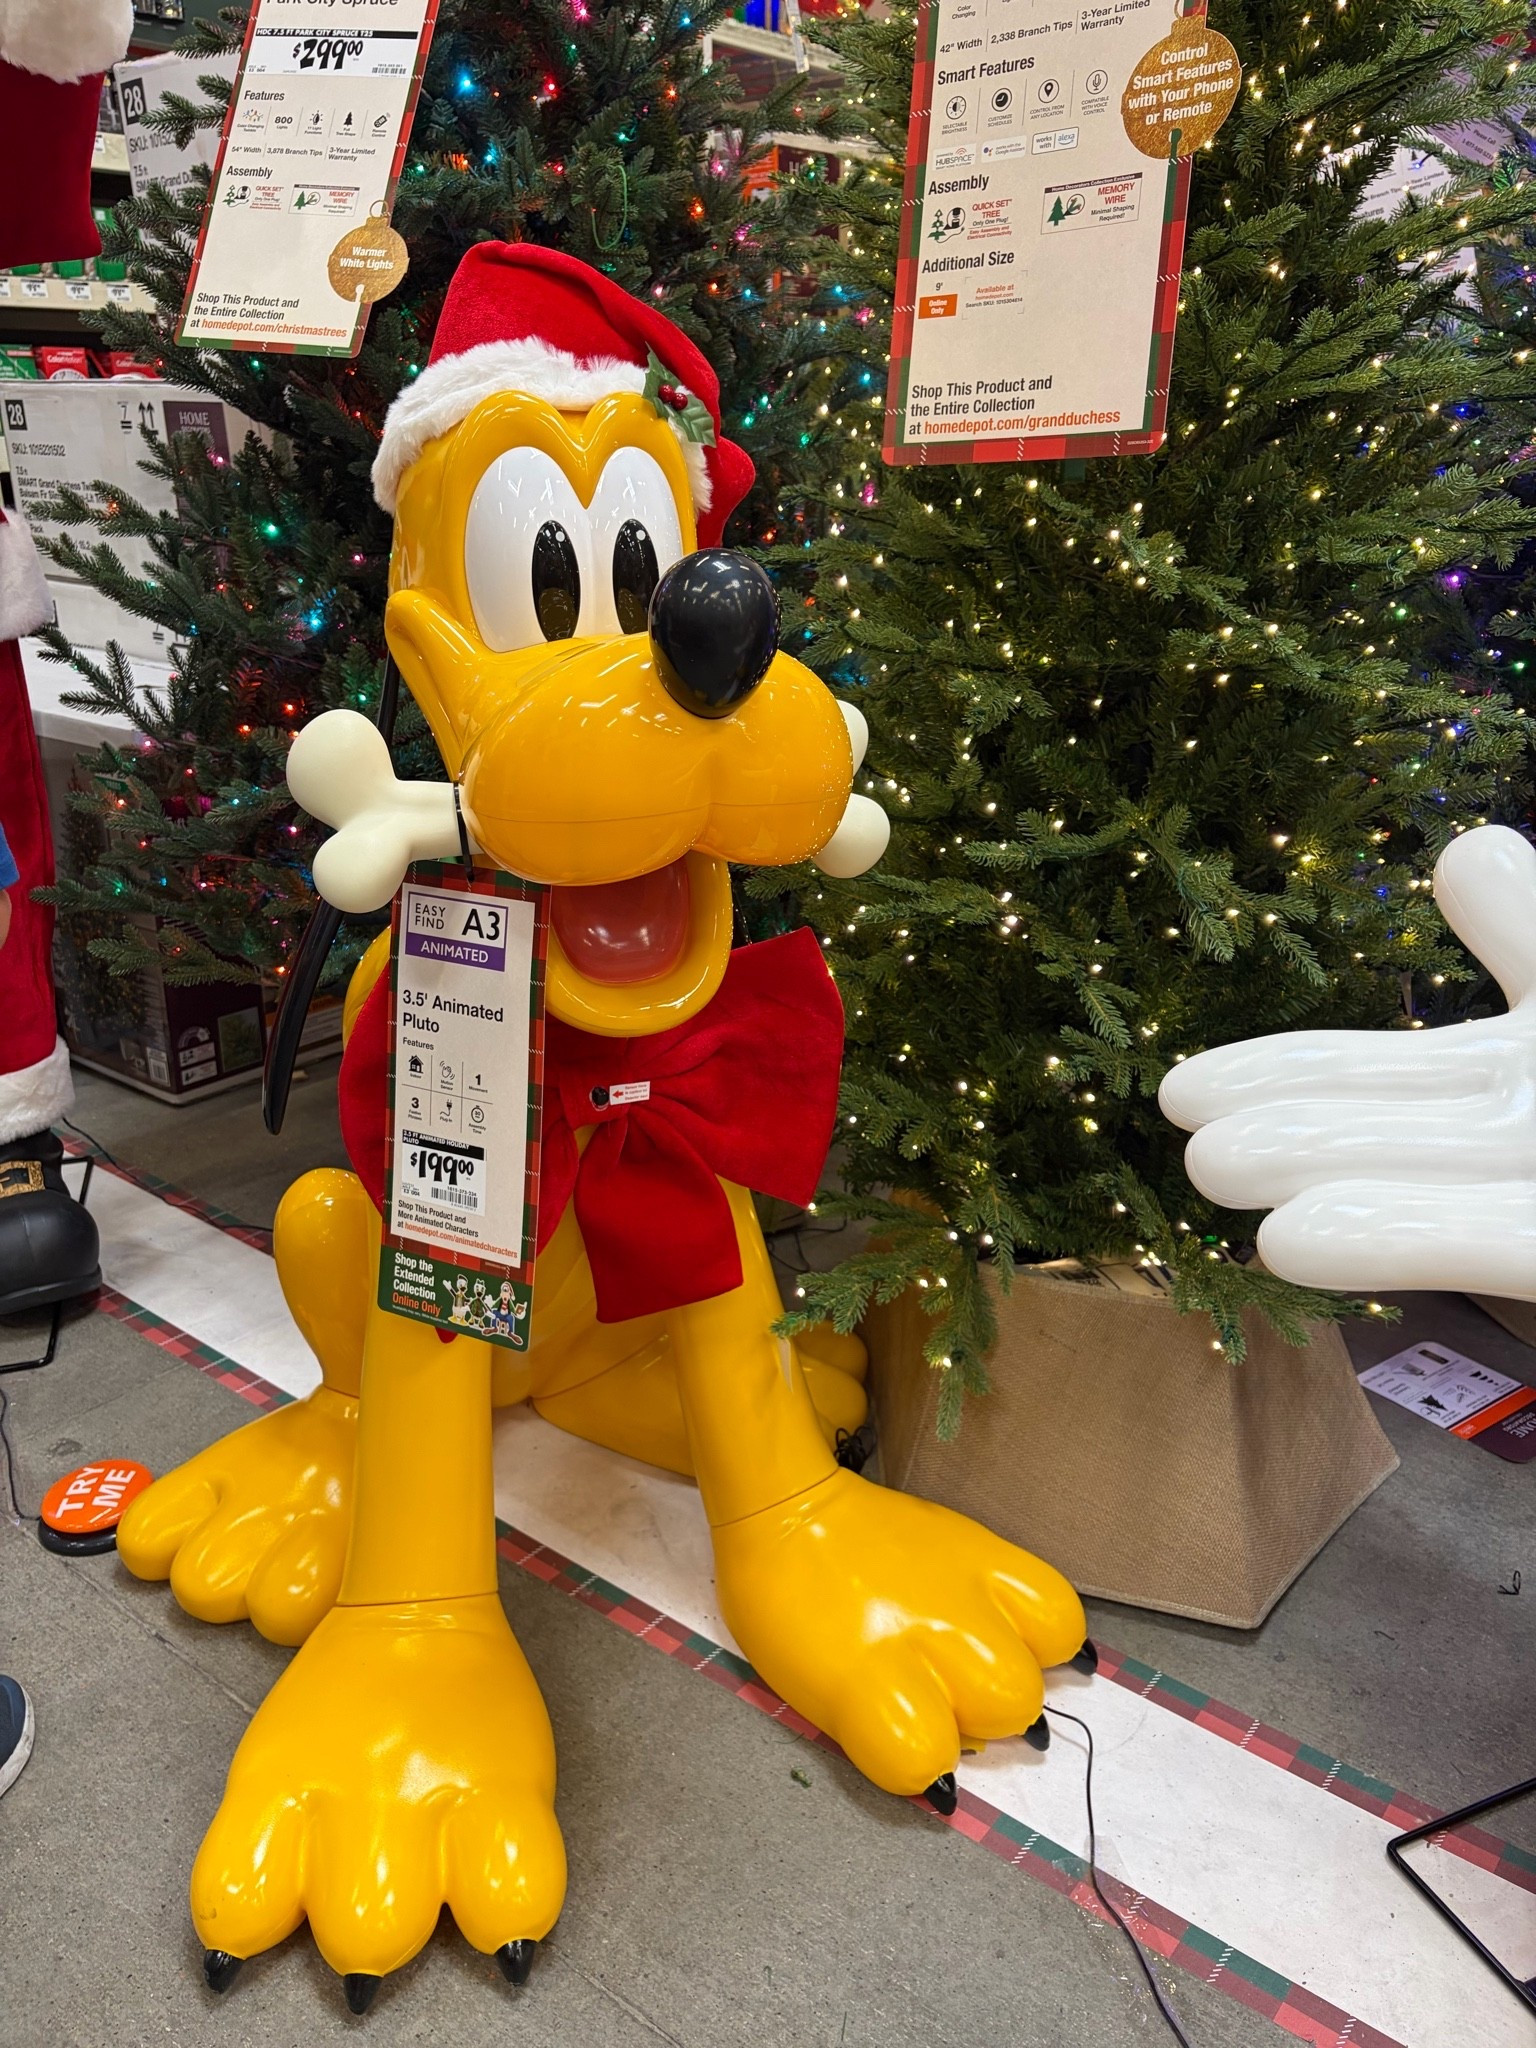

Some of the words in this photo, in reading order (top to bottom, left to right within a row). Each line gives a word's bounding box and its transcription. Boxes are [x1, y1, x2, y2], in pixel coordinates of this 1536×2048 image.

[951, 10, 976, 20] Changing
[957, 4, 972, 12] Color
[1081, 6, 1112, 21] 3-Year
[1114, 0, 1151, 13] Limited
[1081, 15, 1125, 31] Warranty
[991, 31, 1016, 45] 2,338
[1017, 25, 1050, 39] Branch
[1053, 20, 1073, 33] Tips
[940, 43, 955, 53] 42"
[956, 38, 982, 51] Width
[1161, 43, 1209, 66] Control
[937, 66, 975, 86] Smart
[979, 56, 1035, 78] Features
[1133, 70, 1173, 90] Smart
[1176, 58, 1233, 82] Features
[244, 90, 285, 101] Features
[1081, 96, 1110, 105] COMPATIBLE
[1128, 92, 1157, 110] with
[1161, 87, 1191, 104] Your
[1193, 77, 1234, 97] Phone
[124, 85, 144, 118] 28
[987, 114, 1013, 122] CUSTOMIZE
[1030, 107, 1051, 115] CONTROL
[1041, 110, 1064, 118] LOCATION
[1083, 108, 1105, 116] CONTROL
[1145, 112, 1160, 126] or
[1163, 101, 1213, 122] Remote
[274, 116, 293, 124] 800
[942, 121, 968, 129] SELECTABLE
[987, 120, 1013, 128] SCHEDULES
[941, 127, 968, 135] BRIGHTNESS
[1058, 133, 1075, 141] alexa
[328, 154, 358, 162] Warranty
[351, 147, 376, 155] Limited
[936, 154, 972, 166] HUBSPACE
[226, 165, 273, 180] Assembly
[928, 174, 990, 196] Assembly
[1065, 182, 1090, 190] Decorators
[1097, 182, 1135, 196] MEMORY
[972, 201, 995, 211] QUICK
[996, 199, 1009, 208] SET
[1104, 194, 1126, 205] WIRE
[982, 210, 1000, 218] TREE
[1091, 207, 1111, 215] Minimal
[1112, 204, 1135, 213] Shaping
[352, 247, 387, 257] Warmer
[339, 257, 364, 268] White
[366, 258, 394, 271] Lights
[921, 252, 985, 274] Additional
[987, 250, 1015, 266] Size
[975, 292, 1014, 301] homedepot.com
[976, 285, 1006, 294] Available
[197, 292, 220, 304] Shop
[223, 294, 241, 305] This
[243, 295, 279, 307] Product
[281, 298, 300, 308] and
[928, 299, 948, 307] Online
[194, 305, 209, 315] the
[210, 306, 237, 317] Entire
[239, 308, 285, 321] Collection
[930, 307, 944, 315] Only
[190, 319, 200, 328] at
[201, 319, 348, 338] homedepot.com/christmastrees
[911, 384, 943, 400] Shop
[947, 382, 972, 397] This
[976, 378, 1025, 395] Product
[1028, 375, 1052, 391] and
[910, 403, 930, 417] the
[934, 400, 969, 416] Entire
[973, 397, 1035, 414] Collection
[8, 404, 24, 426] 28
[179, 411, 210, 426] HOME
[909, 422, 921, 435] at
[924, 410, 1121, 435] homedepot.com/grandduchess
[19, 488, 39, 498] Balsam
[415, 902, 446, 917] EASY
[415, 915, 445, 930] FIND
[461, 908, 500, 941] A3
[420, 940, 489, 963] ANIMATED
[402, 989, 428, 1007] 3.5'
[432, 995, 503, 1022] Animated
[403, 1012, 440, 1033] Pluto
[402, 1037, 435, 1051] Features
[475, 1074, 481, 1086] 1
[411, 1097, 419, 1109] 3
[403, 1136, 419, 1145] PLUTO
[419, 1133, 446, 1145] ANIMATED
[446, 1139, 470, 1150] HOLIDAY
[398, 1199, 414, 1211] Shop
[415, 1203, 428, 1213] This
[429, 1207, 453, 1220] Product
[454, 1214, 466, 1224] and
[397, 1210, 413, 1220] More
[415, 1214, 444, 1228] Animated
[444, 1222, 479, 1238] Characters
[397, 1220, 404, 1228] at
[404, 1221, 518, 1258] homedepot.com/animatedcharacters
[395, 1252, 417, 1270] Shop
[419, 1259, 433, 1273] the
[394, 1265, 435, 1287] Extended
[393, 1278, 436, 1301] Collection
[392, 1291, 419, 1310] Online
[1509, 1417, 1536, 1438] OME
[55, 1466, 106, 1519] TRY
[91, 1469, 137, 1508] ME
